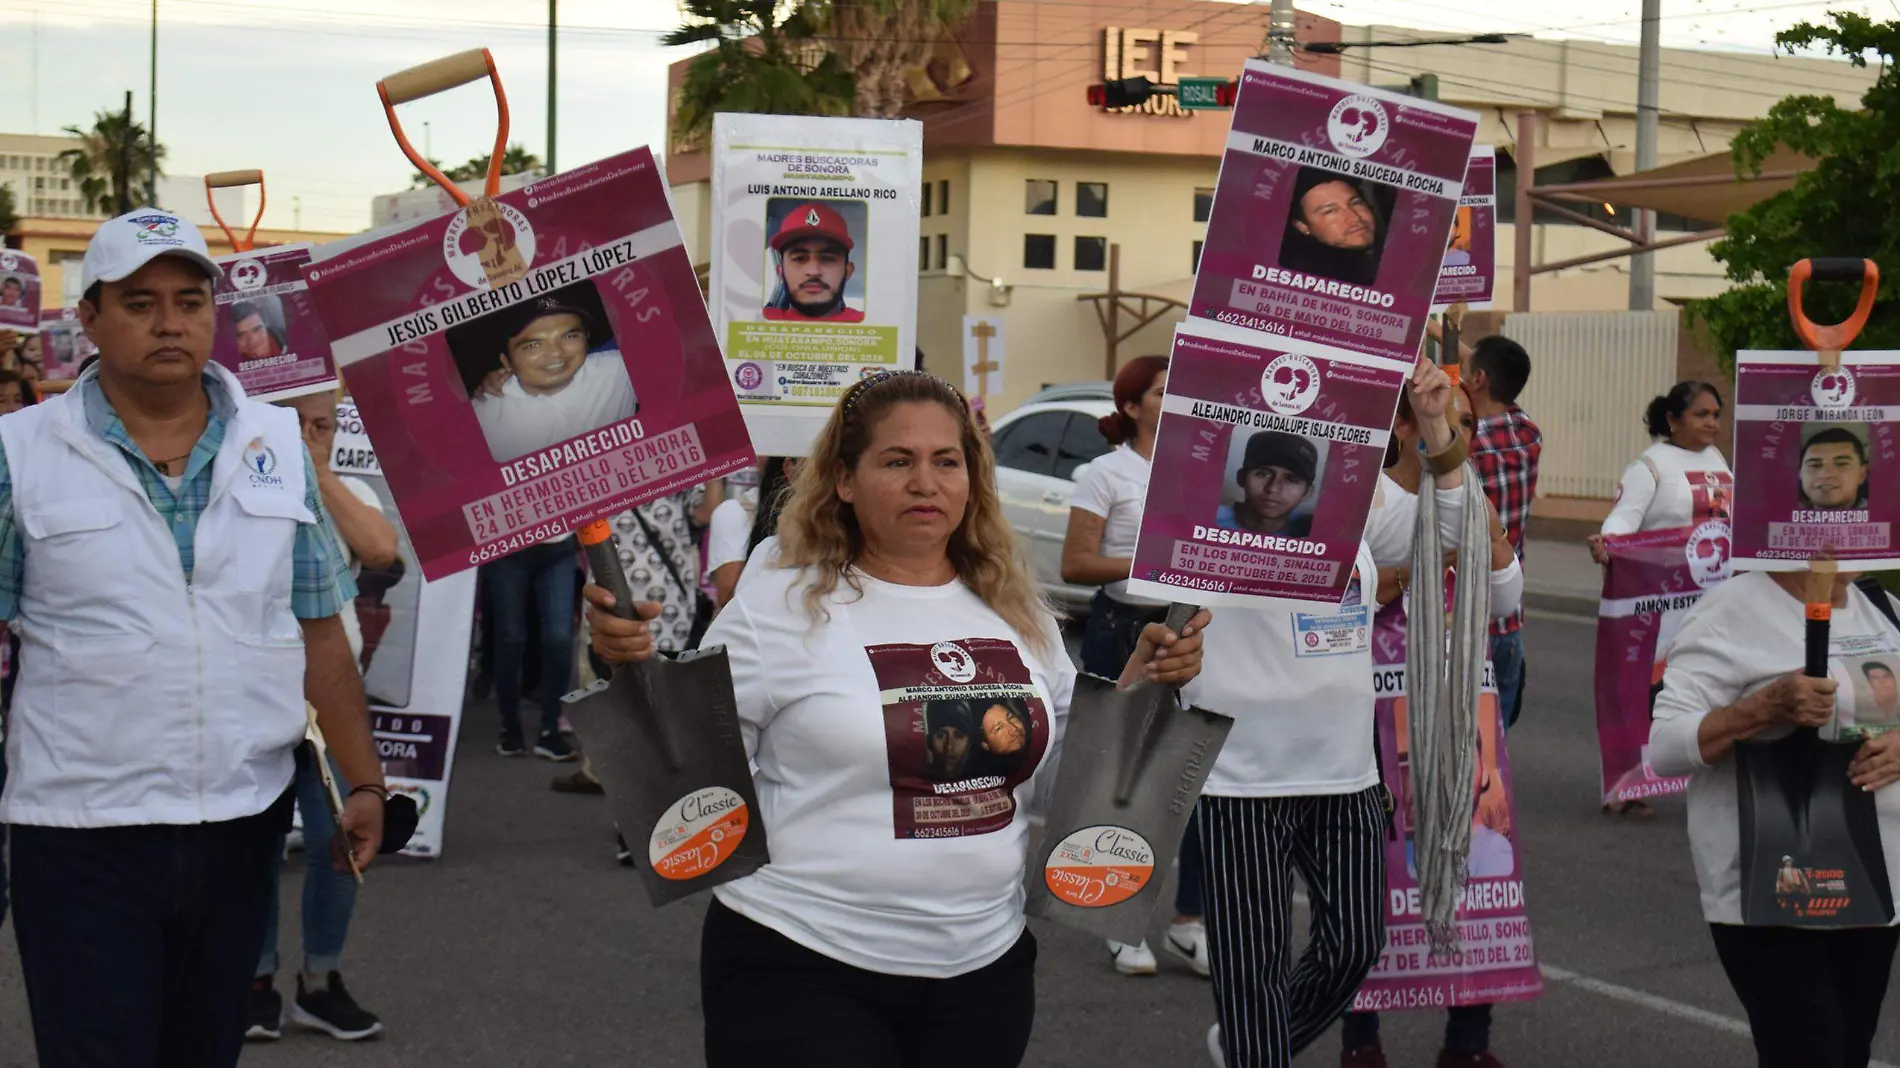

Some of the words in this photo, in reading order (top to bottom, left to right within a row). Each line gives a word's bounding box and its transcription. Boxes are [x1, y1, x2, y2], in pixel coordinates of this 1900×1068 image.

[1105, 26, 1198, 84] IEE
[1183, 86, 1217, 102] ROSALE
[757, 154, 803, 163] MADRES
[805, 156, 878, 166] BUSCADORAS
[788, 164, 802, 172] DE
[805, 164, 850, 173] SONORA
[1253, 139, 1296, 163] MARCO
[1298, 149, 1351, 172] ANTONIO
[1353, 162, 1403, 185] SAUCEDA
[1407, 174, 1443, 195] ROCHA
[748, 184, 770, 194] LUIS
[772, 186, 817, 196] ANTONIO
[820, 187, 870, 198] ARELLANO
[873, 189, 896, 199] RICO
[1440, 265, 1477, 276] PARECIDO
[387, 312, 438, 346] JESÚS
[442, 282, 523, 324] GILBERTO
[528, 260, 579, 298] LÓPEZ
[582, 241, 637, 278] LÓPEZ
[1252, 264, 1395, 308] DESAPARECIDO
[1238, 283, 1257, 297] EN
[1259, 287, 1298, 306] BAHÍA
[1301, 297, 1318, 309] DE
[1320, 300, 1353, 317] KINO,
[1356, 309, 1404, 329] SONORA
[1256, 301, 1271, 314] 04
[1276, 306, 1291, 318] DE
[1295, 308, 1327, 326] MAYO
[1330, 316, 1352, 331] DEL
[746, 325, 876, 335] DESAPARECIDO
[1217, 309, 1285, 335] 6623415616
[769, 351, 782, 359] DE
[786, 352, 834, 360] OCTUBRE
[1191, 402, 1251, 426] ALEJANDRO
[1253, 413, 1309, 435] GUADALUPE
[1309, 422, 1336, 439] ISLAS
[1337, 427, 1371, 444] FLORES
[1776, 409, 1809, 420] JORGE
[1815, 409, 1858, 420] MIRANDA
[501, 419, 645, 487] DESAPARECIDO
[249, 475, 282, 484] CNDH
[471, 501, 495, 522] EN
[500, 458, 620, 513] HERMOSILLO,
[623, 429, 693, 466] SONORA
[475, 518, 499, 541] 24
[507, 510, 528, 530] DE
[536, 481, 612, 519] FEBRERO
[618, 468, 651, 496] DEL
[657, 446, 702, 476] 2016
[469, 521, 562, 565] 6623415616
[597, 455, 749, 515] madresbuscadorasdesonora@gmail.com
[1792, 510, 1869, 523] DESAPARECIDO
[1193, 525, 1327, 556] DESAPARECIDO
[1783, 526, 1795, 535] EN
[1788, 538, 1800, 546] DE
[1848, 537, 1863, 546] DEL
[1181, 544, 1200, 557] EN
[1203, 547, 1227, 561] LOS
[1231, 551, 1281, 569] MOCHIS,
[1284, 558, 1331, 573] SINALOA
[1756, 550, 1811, 560] 6623415616
[1159, 572, 1225, 592] 6623415616
[1178, 557, 1194, 569] 30
[1198, 561, 1215, 573] DE
[1219, 564, 1274, 580] OCTUBRE
[1277, 571, 1298, 583] DEL
[1301, 573, 1327, 585] 2015
[1635, 599, 1669, 615] RAMÓN
[898, 694, 942, 703] ALEJANDRO
[906, 685, 933, 694] MARCO
[934, 685, 967, 693] ANTONIO
[969, 684, 1001, 692] SAUCEDA
[933, 776, 1006, 794] DESAPARECIDO
[1167, 739, 1212, 817] TRUPER
[681, 793, 737, 822] Classic
[915, 827, 959, 838] 6623415616
[662, 841, 718, 873] Classic
[1095, 829, 1149, 863] Classic
[1052, 869, 1105, 903] Classic
[1390, 879, 1524, 916] DEPARECID
[1397, 953, 1419, 970] DE
[1426, 949, 1485, 968] AGOSTO
[1488, 948, 1510, 963] DEL
[1355, 987, 1444, 1010] 6623415616
